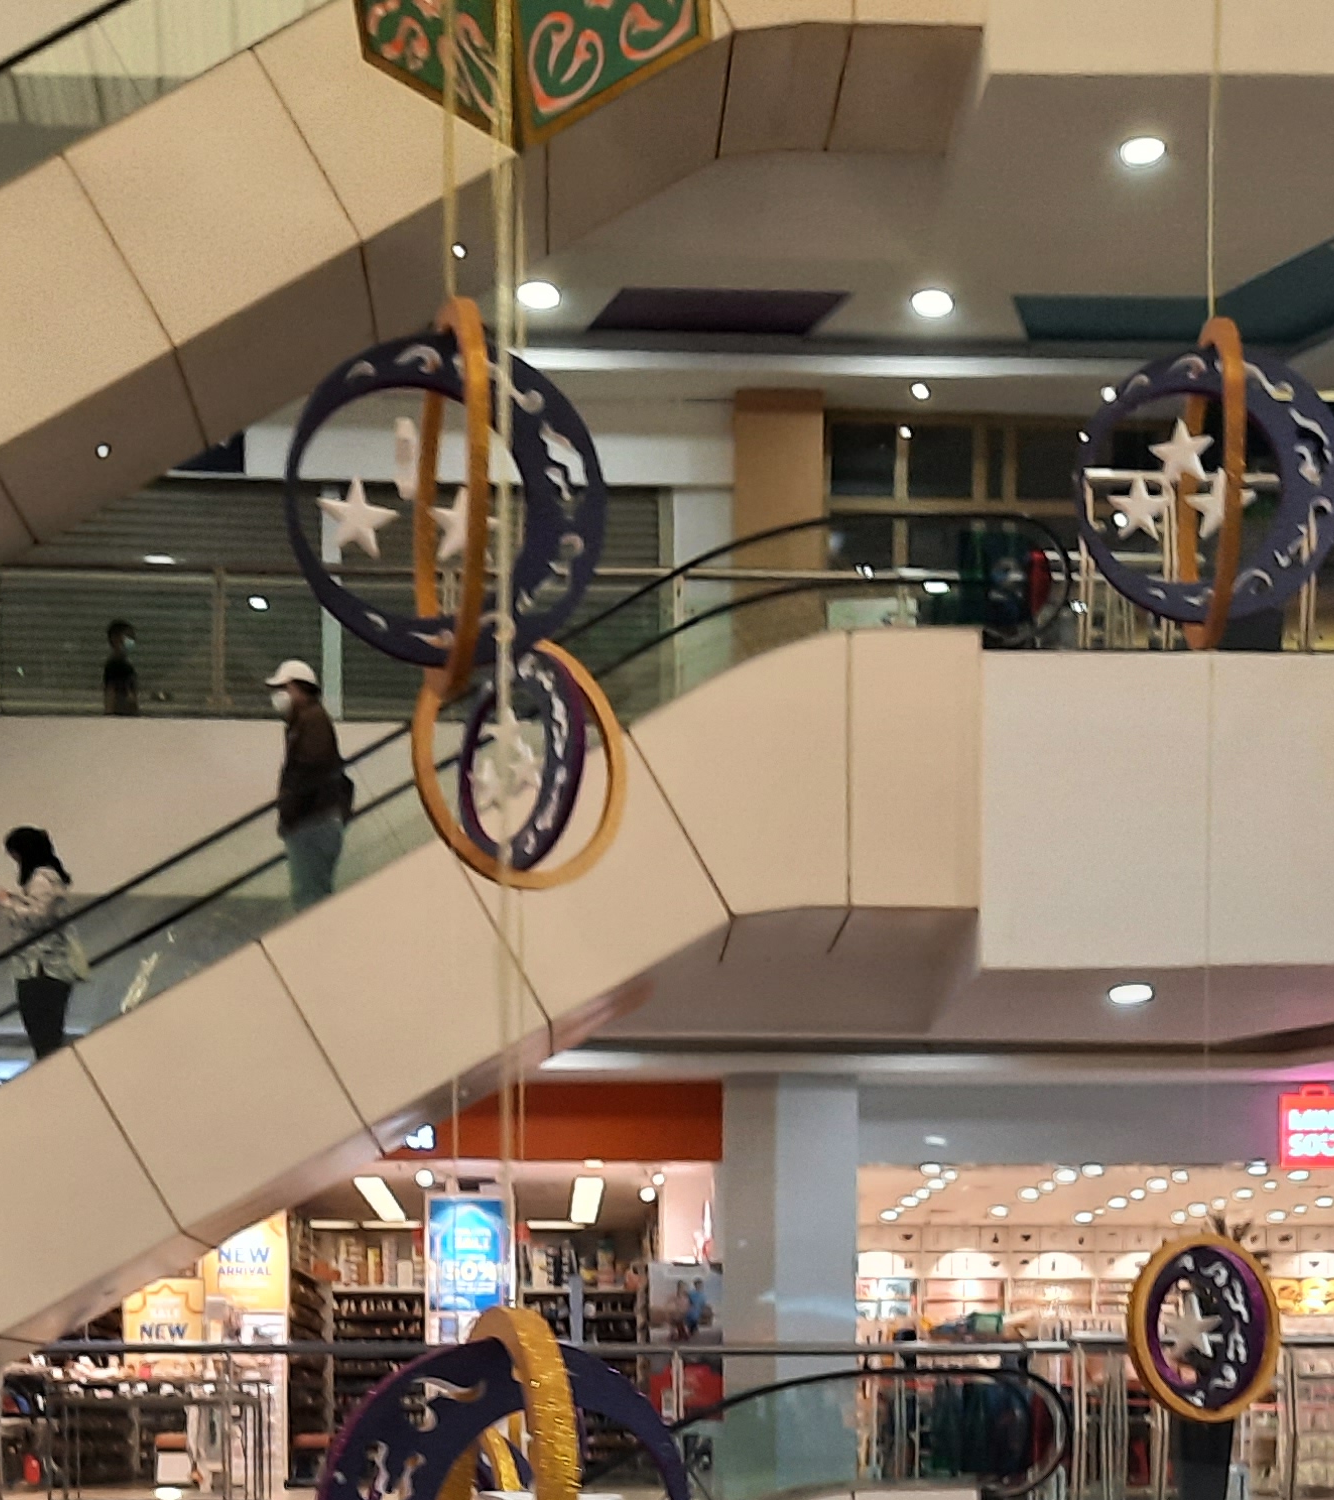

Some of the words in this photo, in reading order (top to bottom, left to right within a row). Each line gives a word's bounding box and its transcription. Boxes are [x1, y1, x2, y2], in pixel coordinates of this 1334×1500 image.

[217, 1247, 271, 1264] NEW
[217, 1266, 272, 1276] ARRIVAL
[139, 1322, 189, 1341] NEW
